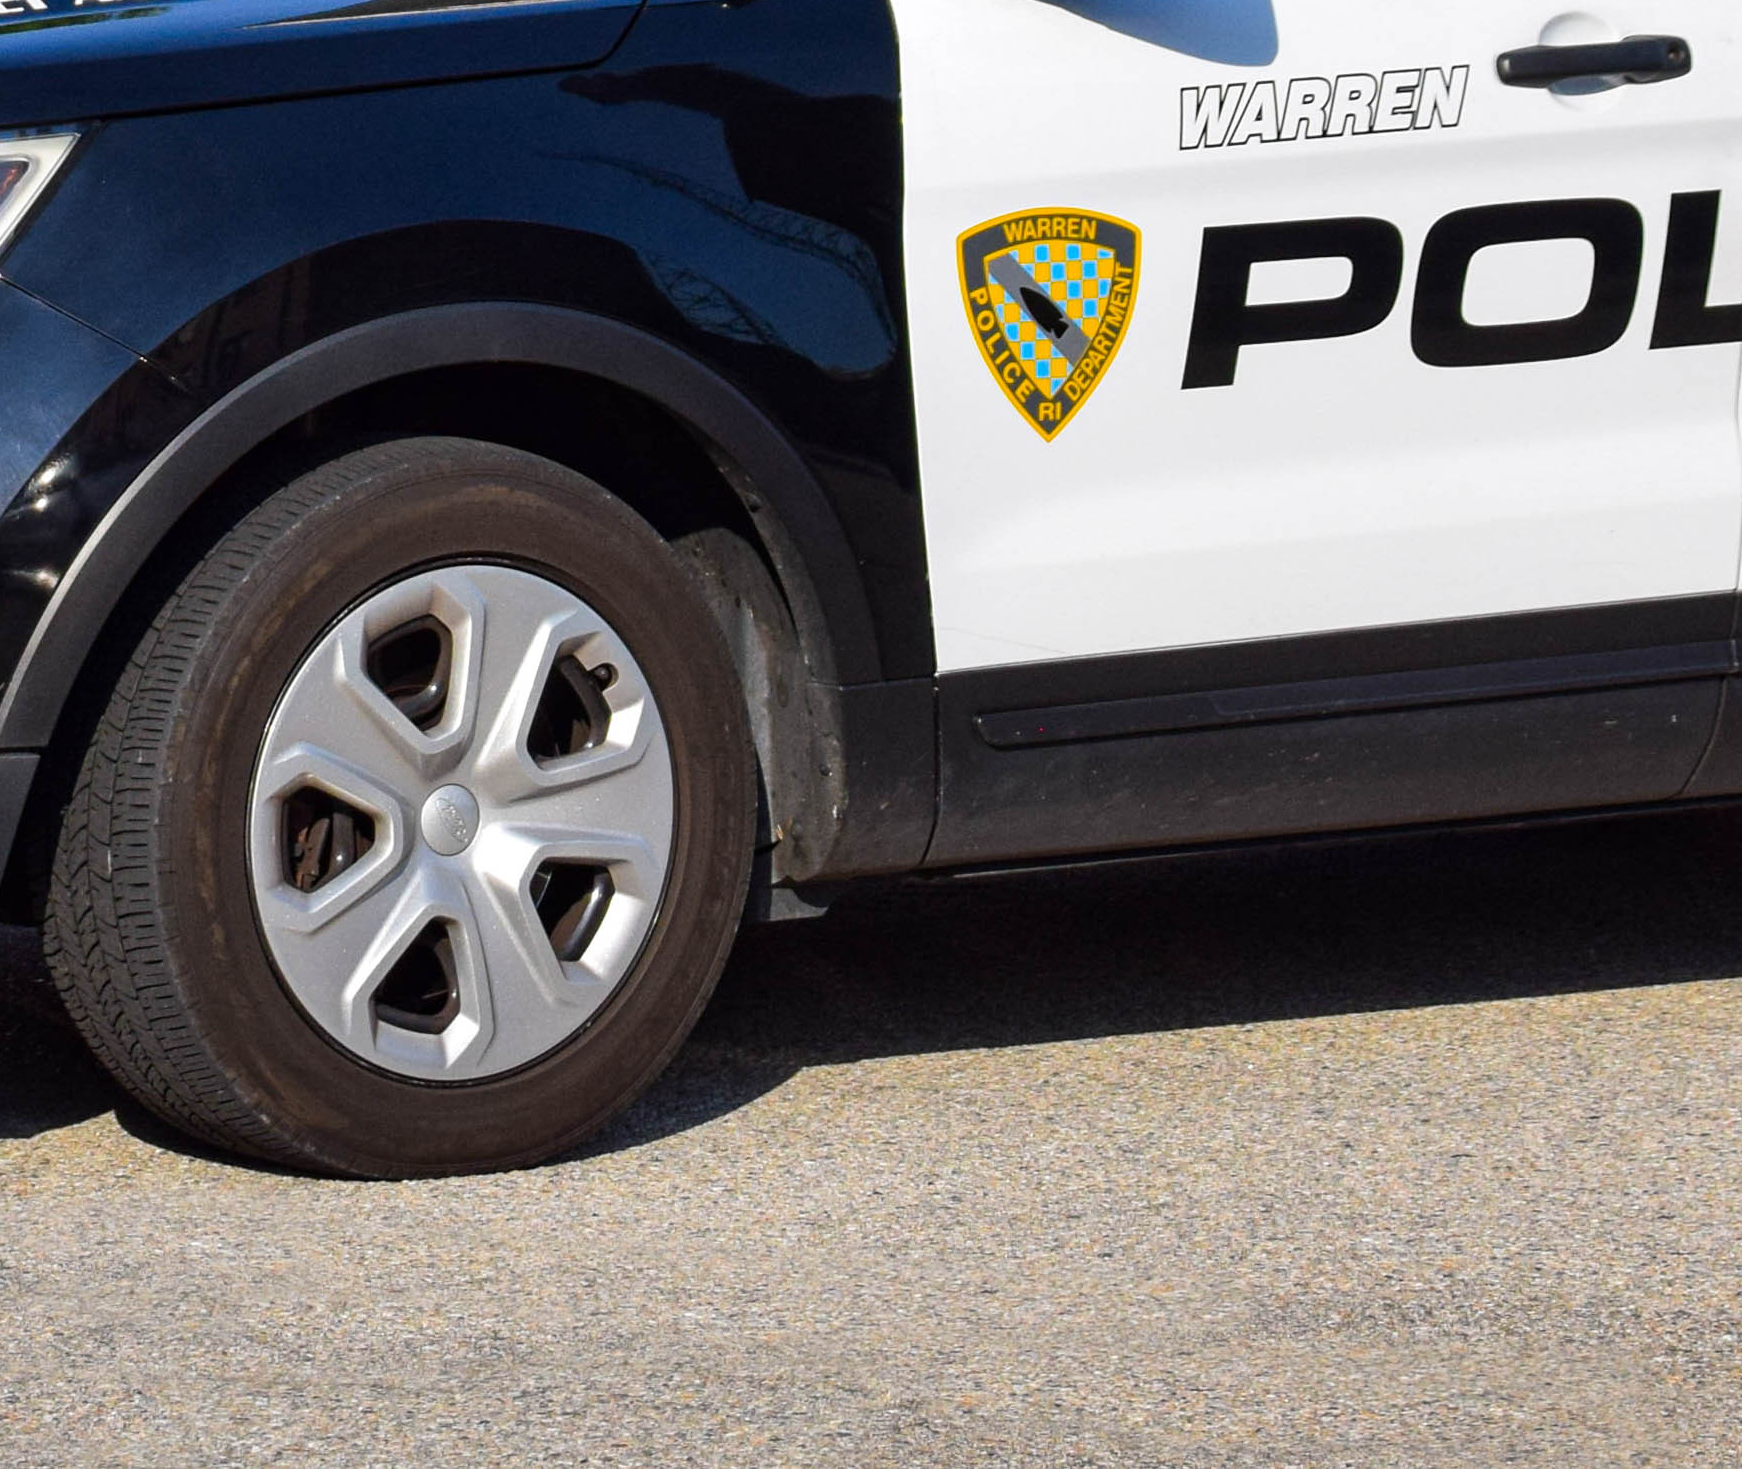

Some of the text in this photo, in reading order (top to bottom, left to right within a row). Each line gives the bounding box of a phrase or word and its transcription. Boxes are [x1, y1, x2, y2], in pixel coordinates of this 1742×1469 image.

[1179, 64, 1470, 151] WARREN
[1002, 217, 1098, 243] WARREN
[969, 286, 1036, 403] POLICE
[1062, 261, 1134, 403] DEPARTMENT
[1038, 401, 1063, 422] RI
